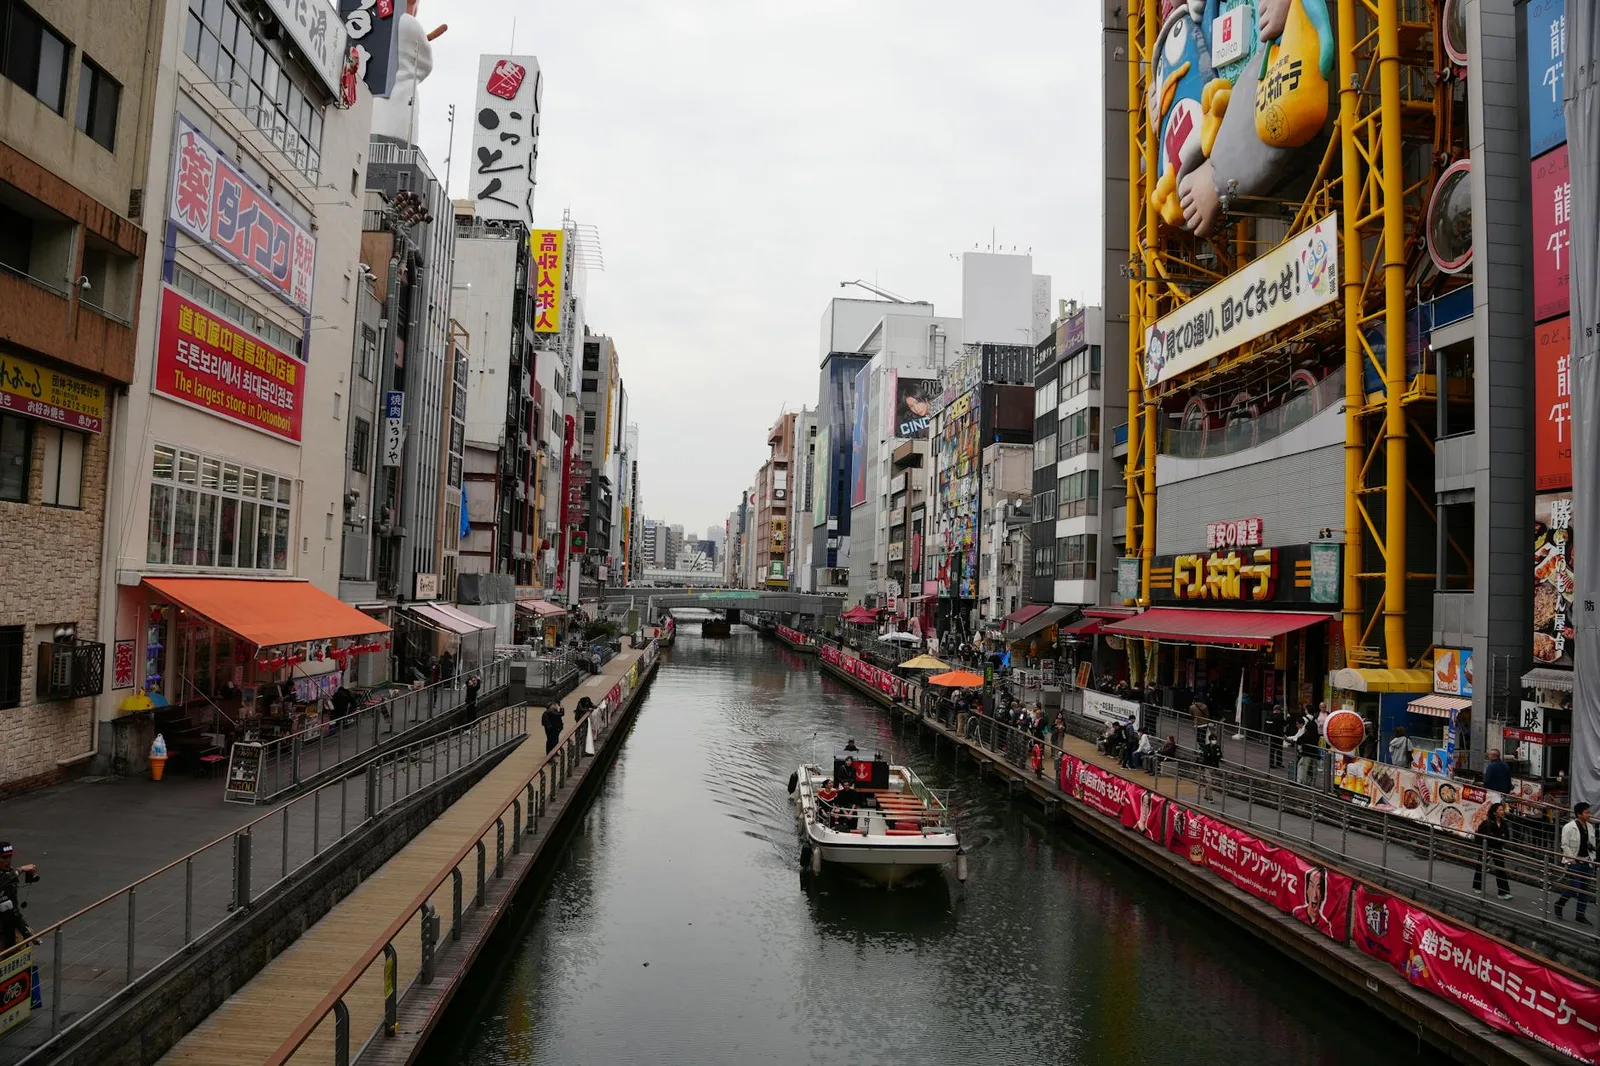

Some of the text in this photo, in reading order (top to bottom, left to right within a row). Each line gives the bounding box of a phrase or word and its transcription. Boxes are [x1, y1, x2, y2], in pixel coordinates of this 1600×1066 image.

[1542, 60, 1565, 103] ダ
[175, 131, 214, 232] 薬
[216, 178, 292, 282] ダイコク
[1546, 229, 1570, 270] ダ
[535, 232, 558, 330] 高収入求人
[175, 339, 242, 389] 도톤보리에서
[27, 400, 65, 420] お好み焼き
[78, 414, 99, 429] 串かつ
[174, 369, 192, 394] The
[194, 376, 224, 407] largest
[225, 394, 246, 415] store
[247, 400, 255, 419] in
[390, 394, 402, 418] 焼肉
[387, 419, 400, 464] いろりや
[1548, 403, 1571, 443] ダ
[1206, 517, 1263, 549] 驚安の殿堂
[1550, 498, 1571, 530] 勝
[1584, 600, 1595, 612] 防
